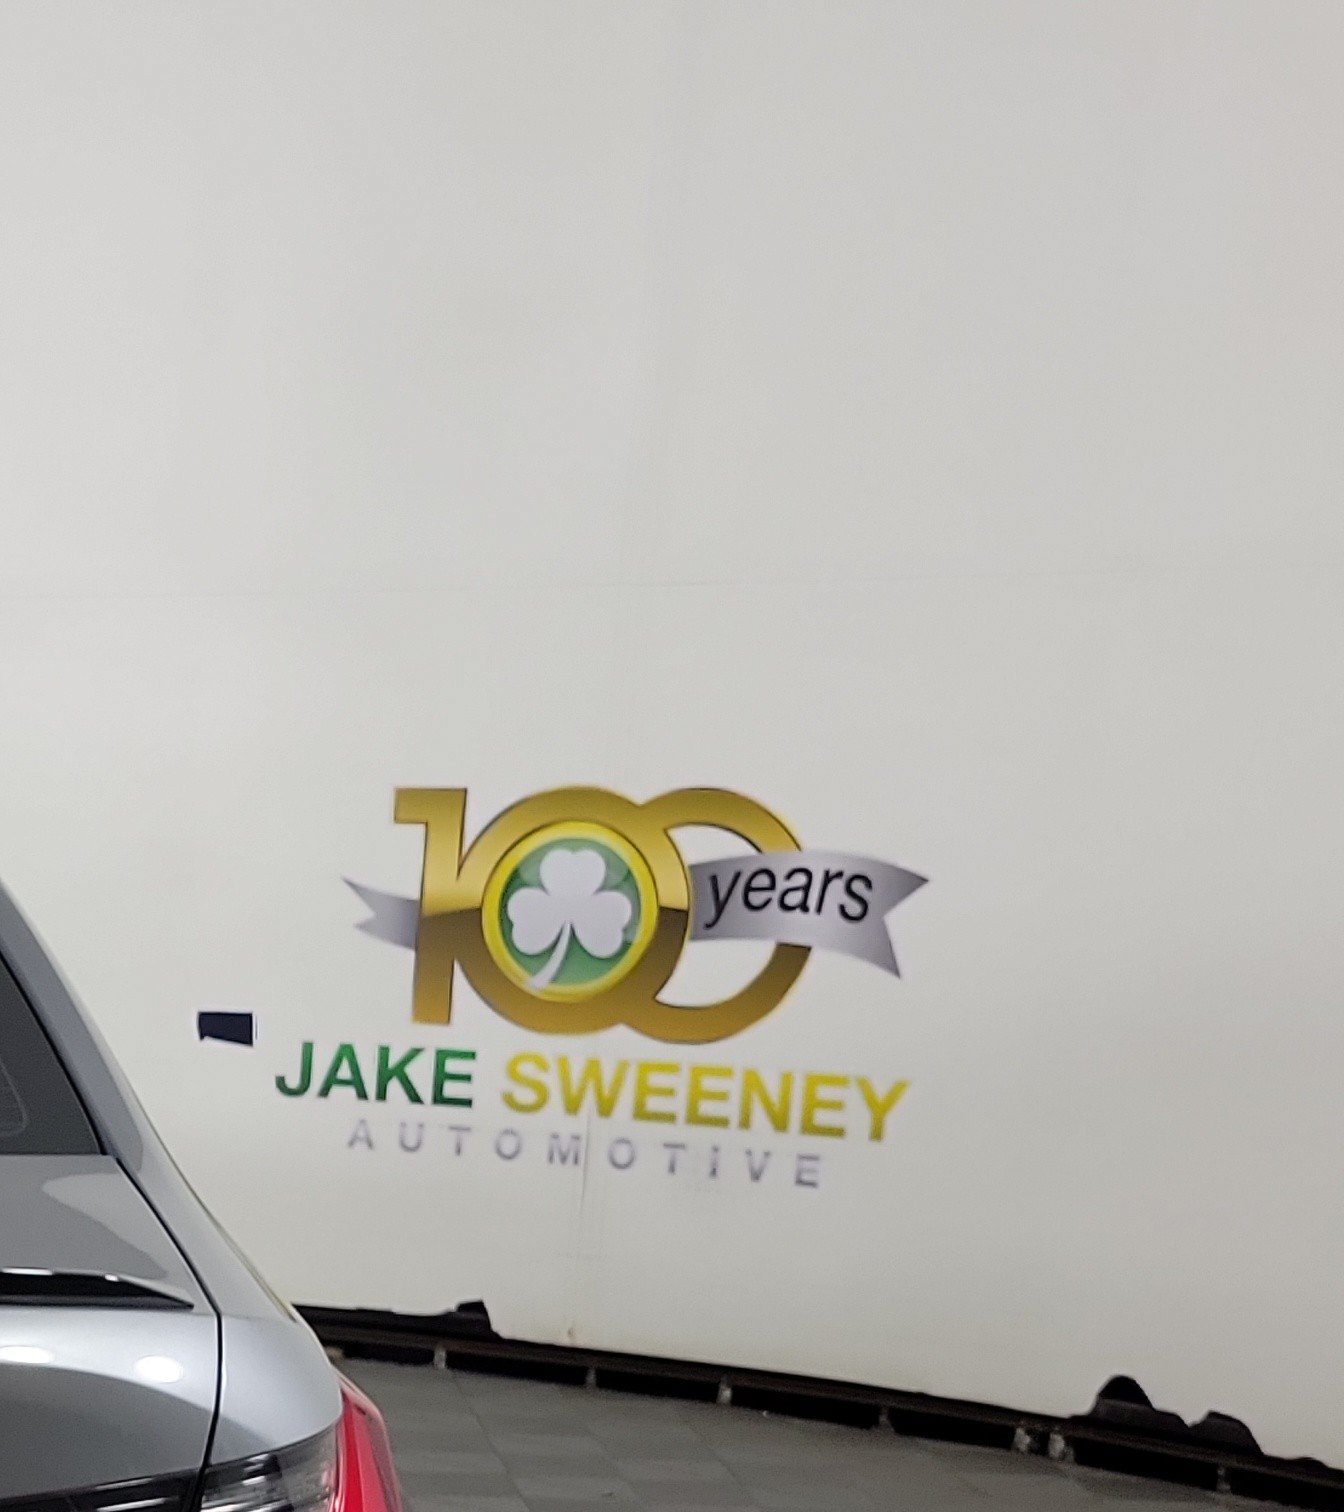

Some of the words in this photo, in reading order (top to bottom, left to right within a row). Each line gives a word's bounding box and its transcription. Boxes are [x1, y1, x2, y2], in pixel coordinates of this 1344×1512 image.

[393, 786, 812, 1045] 100
[703, 866, 873, 929] years
[274, 1041, 477, 1109] JAKE
[500, 1051, 911, 1143] SWEENEY
[347, 1118, 823, 1189] AUTOMOTIVE
